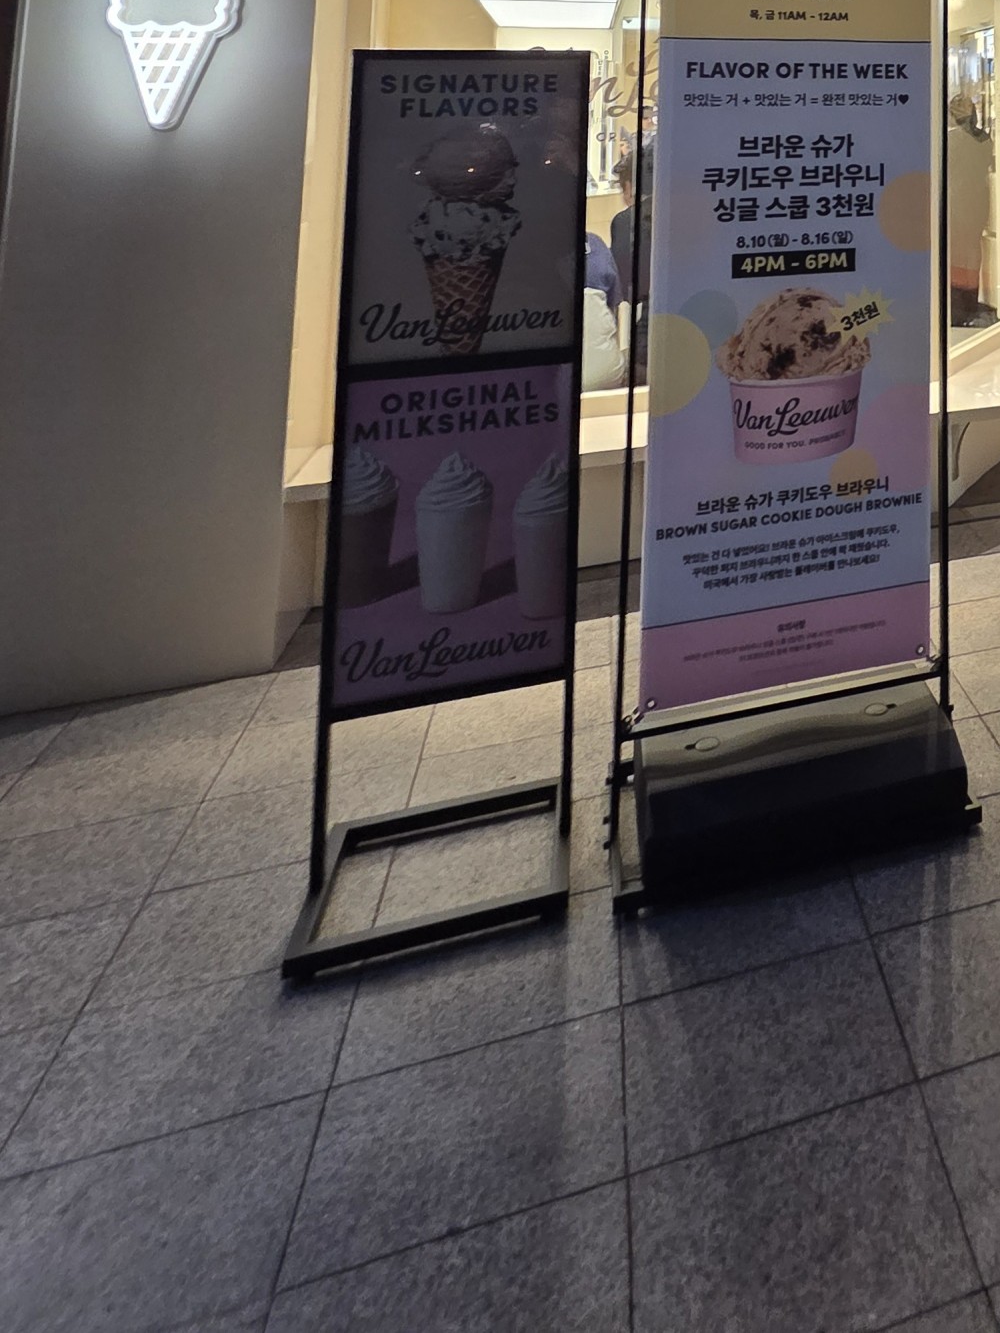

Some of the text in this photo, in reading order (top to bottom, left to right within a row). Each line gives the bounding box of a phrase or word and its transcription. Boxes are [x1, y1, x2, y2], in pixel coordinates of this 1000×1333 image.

[778, 11, 806, 21] 11AM
[818, 12, 849, 22] 12AM
[380, 73, 558, 94] SIGNATURE
[686, 61, 909, 80] FLAVOR OF THE WEEK
[400, 97, 538, 118] FLAVORS
[684, 93, 723, 107] 맛있는
[725, 93, 738, 107] 거
[754, 93, 792, 107] 맛있는
[794, 93, 807, 107] 거
[821, 93, 846, 107] 완전
[848, 93, 884, 107] 맛있는
[737, 133, 854, 159] 브라운 슈가
[702, 163, 885, 192] 쿠키도우 브라우니
[714, 192, 875, 223] 싱글 스쿱 3천원
[736, 233, 789, 249] 8.10(월)
[801, 231, 853, 246] 8.16(일)
[740, 255, 785, 273] 4PM
[806, 252, 848, 269] 6PM
[359, 298, 564, 347] Van Leeuwen
[841, 302, 881, 331] 3천원
[381, 381, 538, 414] ORIGINAL
[352, 403, 560, 444] MILKSHAKES
[734, 398, 774, 430] Van
[767, 442, 784, 450] FOR
[696, 476, 890, 516] 브라운 슈가 쿠키도우 브라우니
[656, 492, 922, 541] BROWN SUGAR COOKIE DOUGH BROWNIE
[722, 548, 731, 559] 다
[772, 539, 797, 551] 브라운
[798, 537, 814, 547] 슈가
[740, 572, 758, 584] 가장
[340, 626, 549, 683] Van Leeuwen
